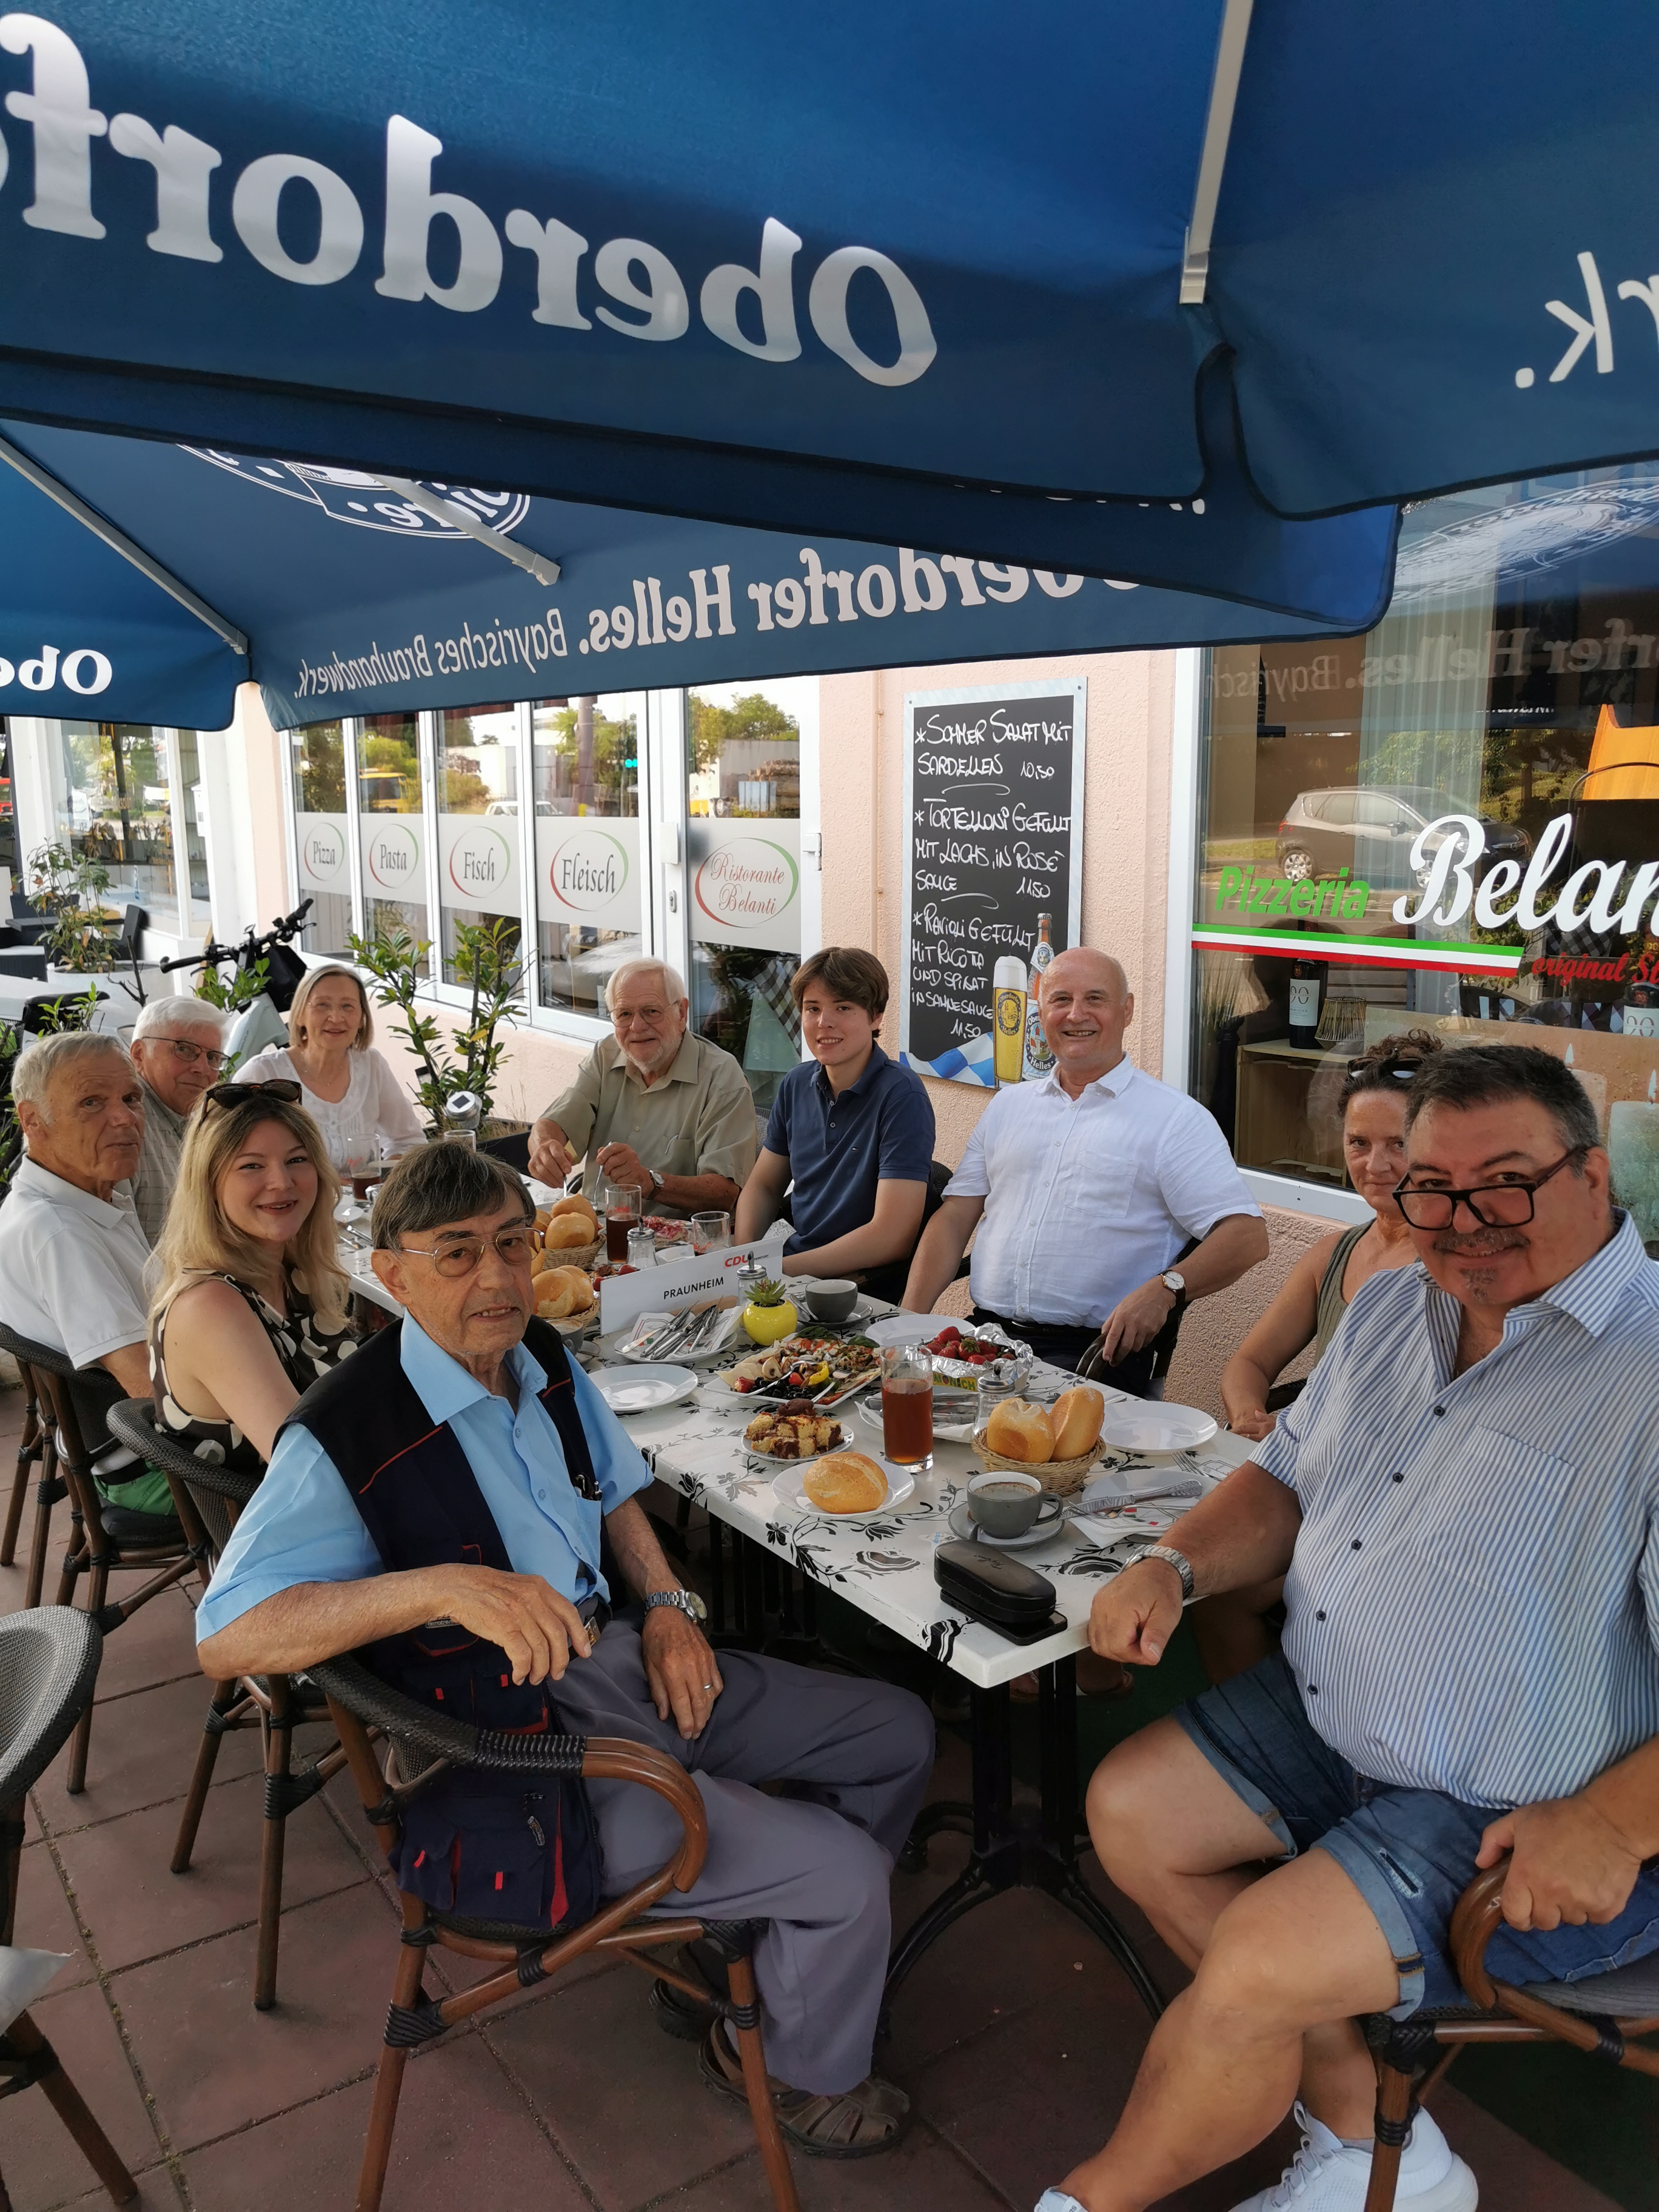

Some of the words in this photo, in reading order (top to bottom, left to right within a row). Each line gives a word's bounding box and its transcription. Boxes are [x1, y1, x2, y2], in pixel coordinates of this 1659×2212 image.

[990, 709, 1041, 744] SALAT
[917, 752, 1004, 777] SARDELLEN
[312, 840, 336, 866] Pizza
[380, 843, 407, 871] Pasta
[463, 847, 495, 883] Fisch
[561, 852, 616, 894] Fleisch
[711, 852, 785, 885] Ristorante
[915, 870, 957, 891] SAUCE
[719, 883, 777, 915] Belanti
[1215, 865, 1370, 919] Pizzeria
[913, 966, 942, 987] UND
[1532, 951, 1630, 987] original
[1030, 1056, 1051, 1070] Helles
[725, 1254, 748, 1268] CDU
[663, 1276, 725, 1300] PRAUNHEIM
